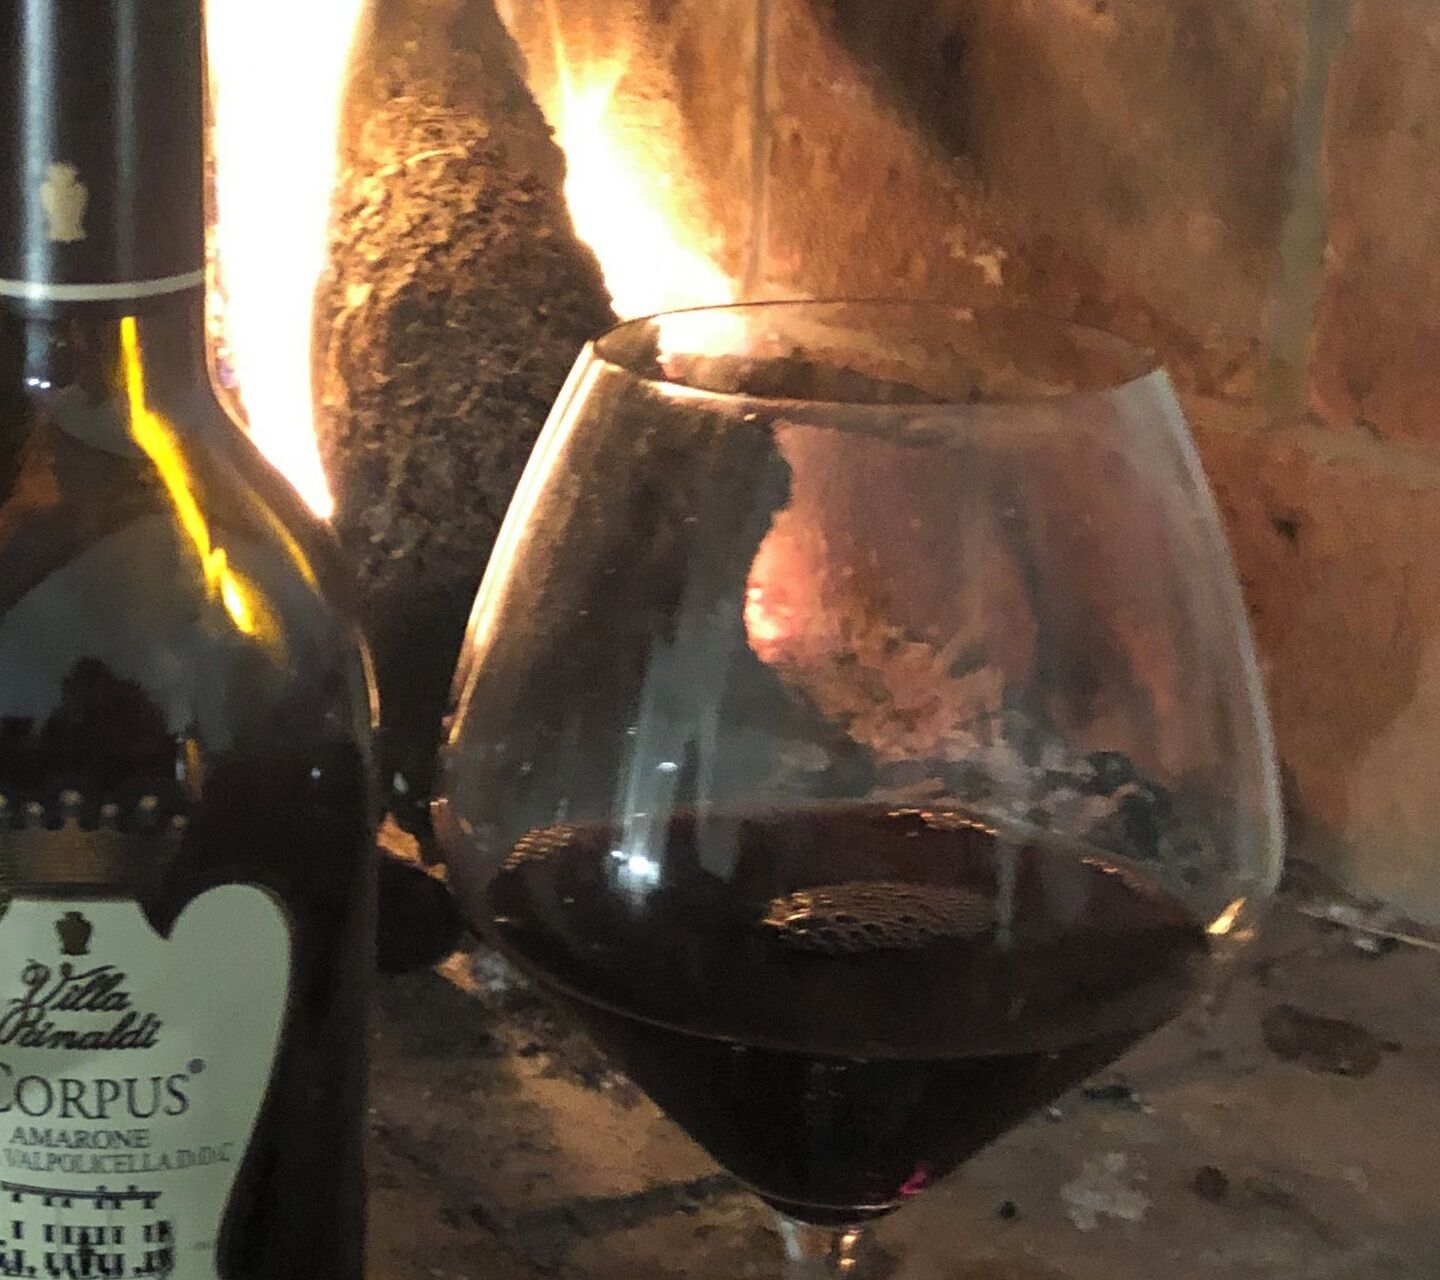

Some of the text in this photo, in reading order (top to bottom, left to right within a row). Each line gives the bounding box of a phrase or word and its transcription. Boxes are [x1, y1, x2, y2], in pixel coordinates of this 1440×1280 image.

[16, 958, 132, 1011] Villa
[9, 1126, 151, 1149] AMARONE
[4, 1148, 173, 1173] VALPOLICELLA
